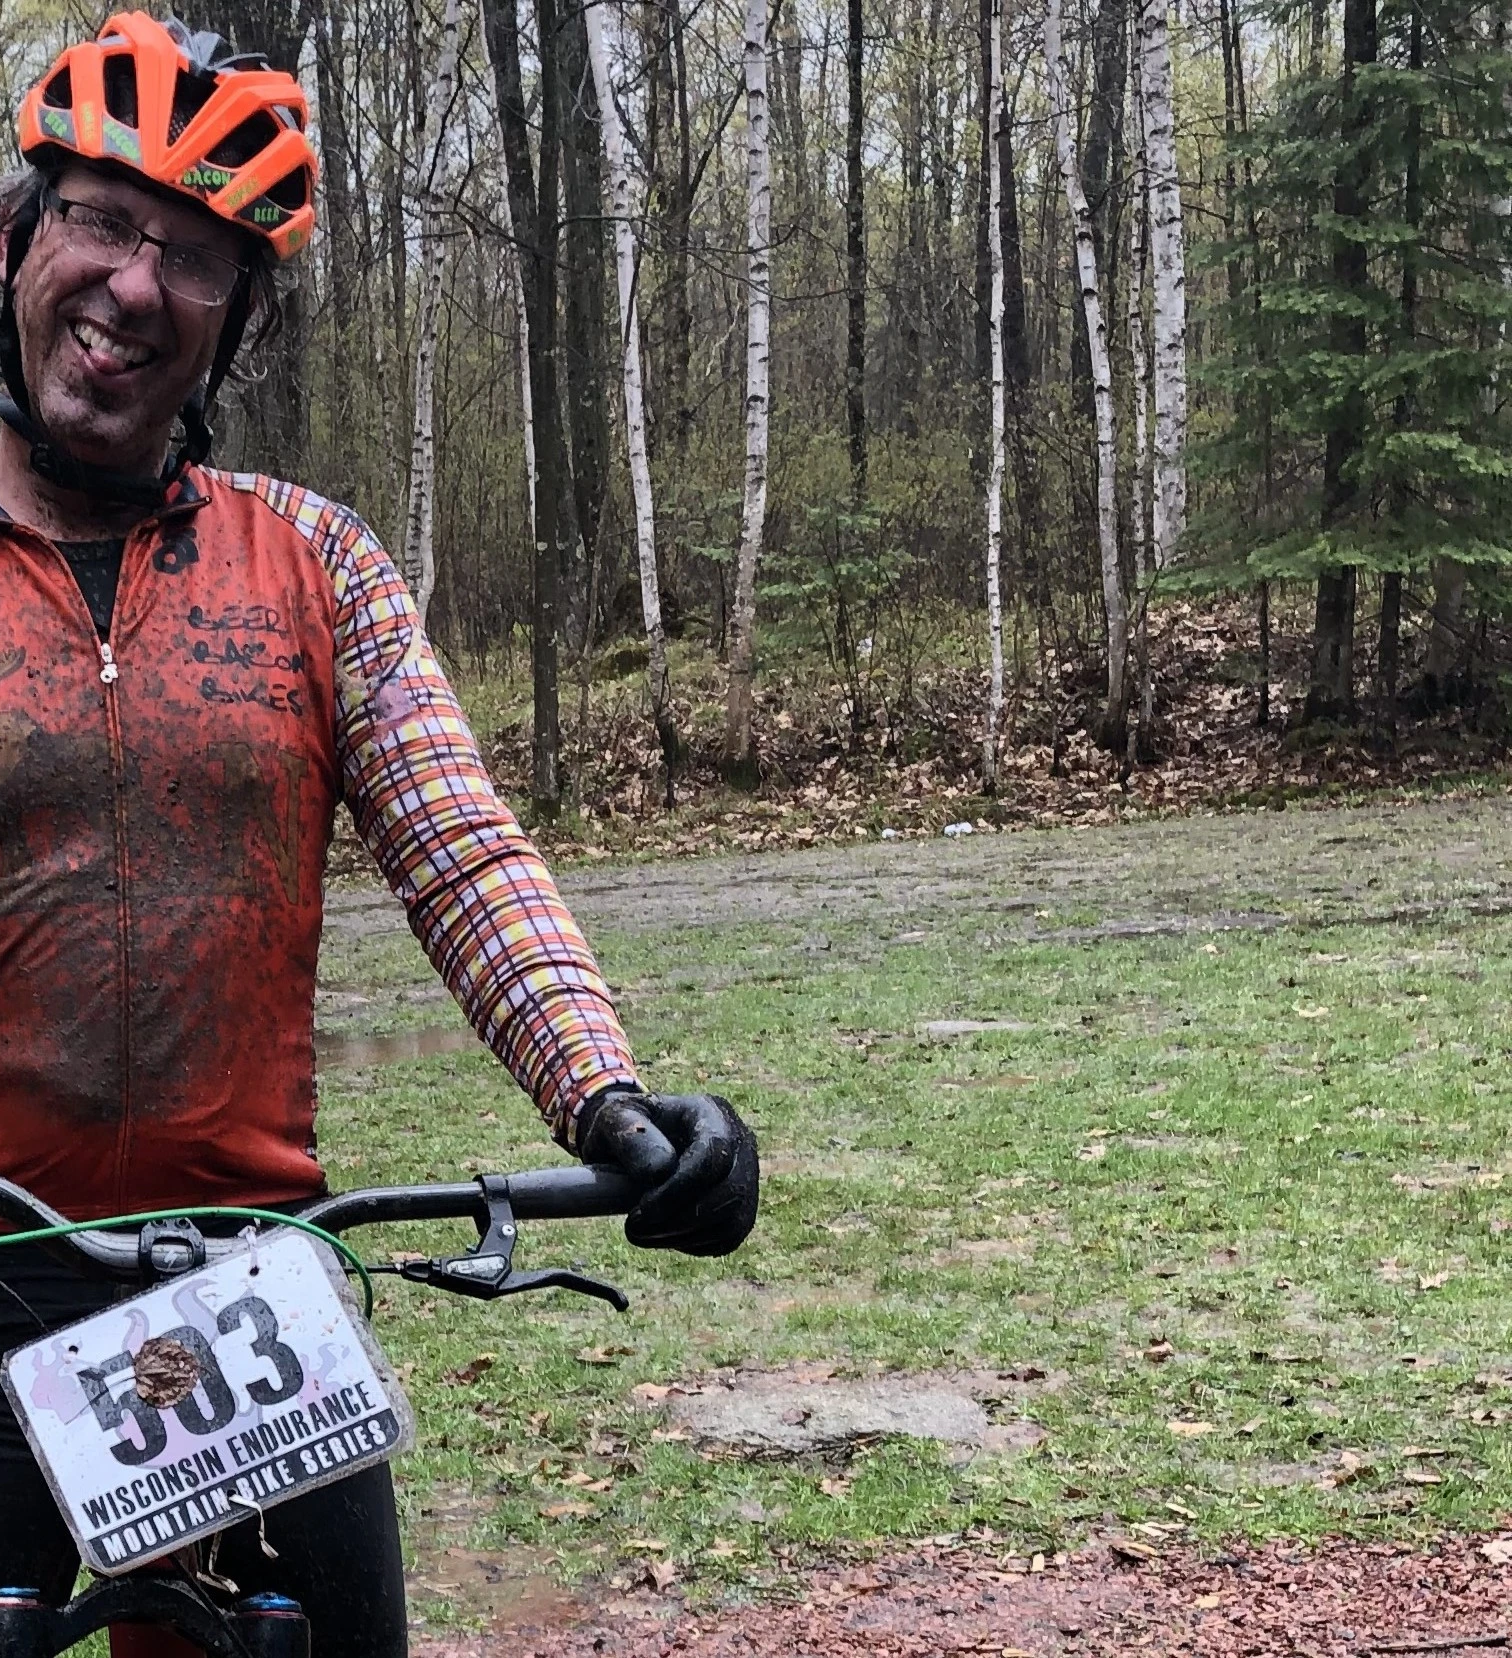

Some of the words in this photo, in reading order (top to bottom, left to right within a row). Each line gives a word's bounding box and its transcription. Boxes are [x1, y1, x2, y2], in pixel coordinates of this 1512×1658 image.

[183, 167, 231, 186] BACON
[254, 207, 280, 222] BEER
[188, 605, 289, 639] BEER
[200, 677, 303, 716] BIKES
[76, 1296, 303, 1466] 503
[81, 1445, 227, 1530] WISCONSIN
[226, 1380, 377, 1467] ENDURANCE
[101, 1486, 231, 1563] MOUNTAIN
[235, 1459, 295, 1501] BIKE
[299, 1419, 386, 1476] SERIES
